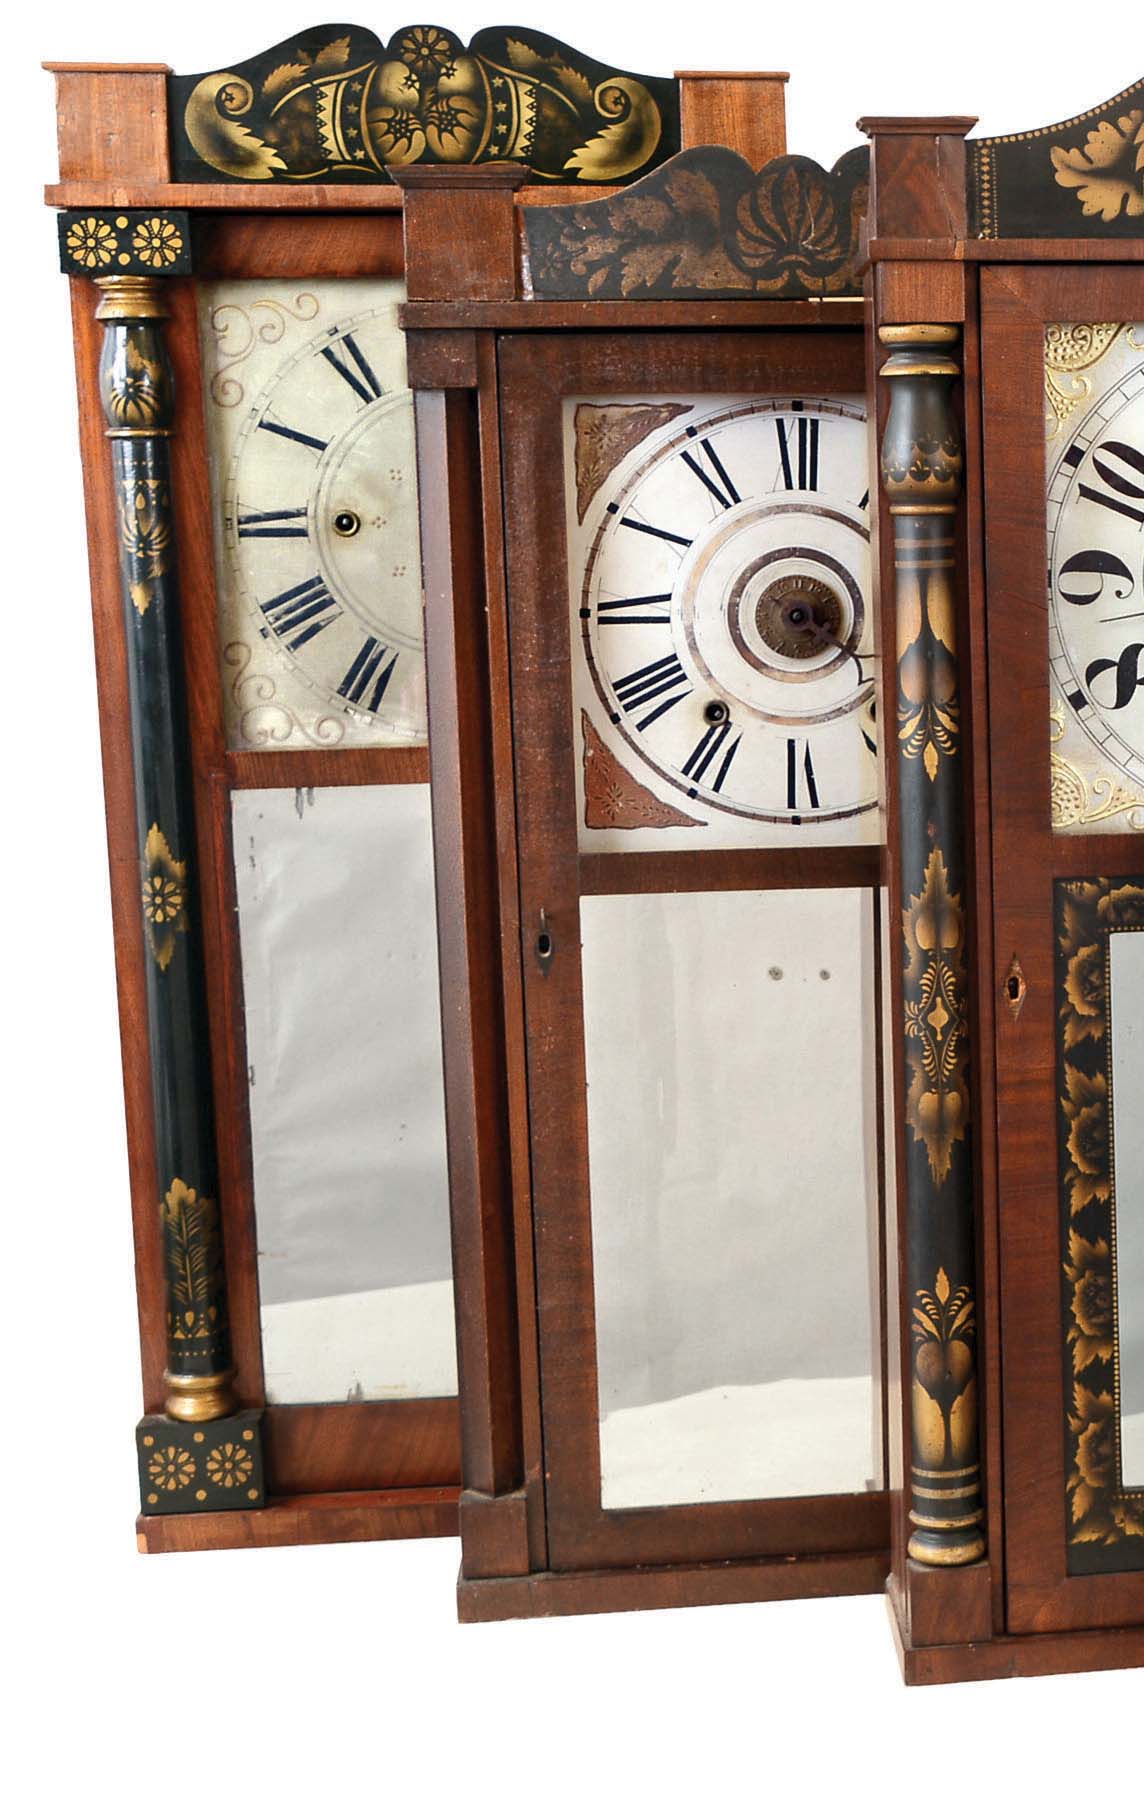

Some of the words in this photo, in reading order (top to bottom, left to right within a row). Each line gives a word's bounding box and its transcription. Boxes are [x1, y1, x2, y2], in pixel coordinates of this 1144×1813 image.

[314, 329, 393, 412] XI
[255, 400, 336, 468] X
[770, 416, 824, 493] XII
[676, 435, 746, 520] XI
[236, 497, 310, 544] IX
[616, 499, 694, 562] X
[256, 572, 344, 652] VIII
[597, 588, 673, 625] IX
[1058, 549, 1134, 606] 9
[332, 632, 399, 713] VII
[612, 653, 694, 733] VIII
[786, 738, 821, 810] VI
